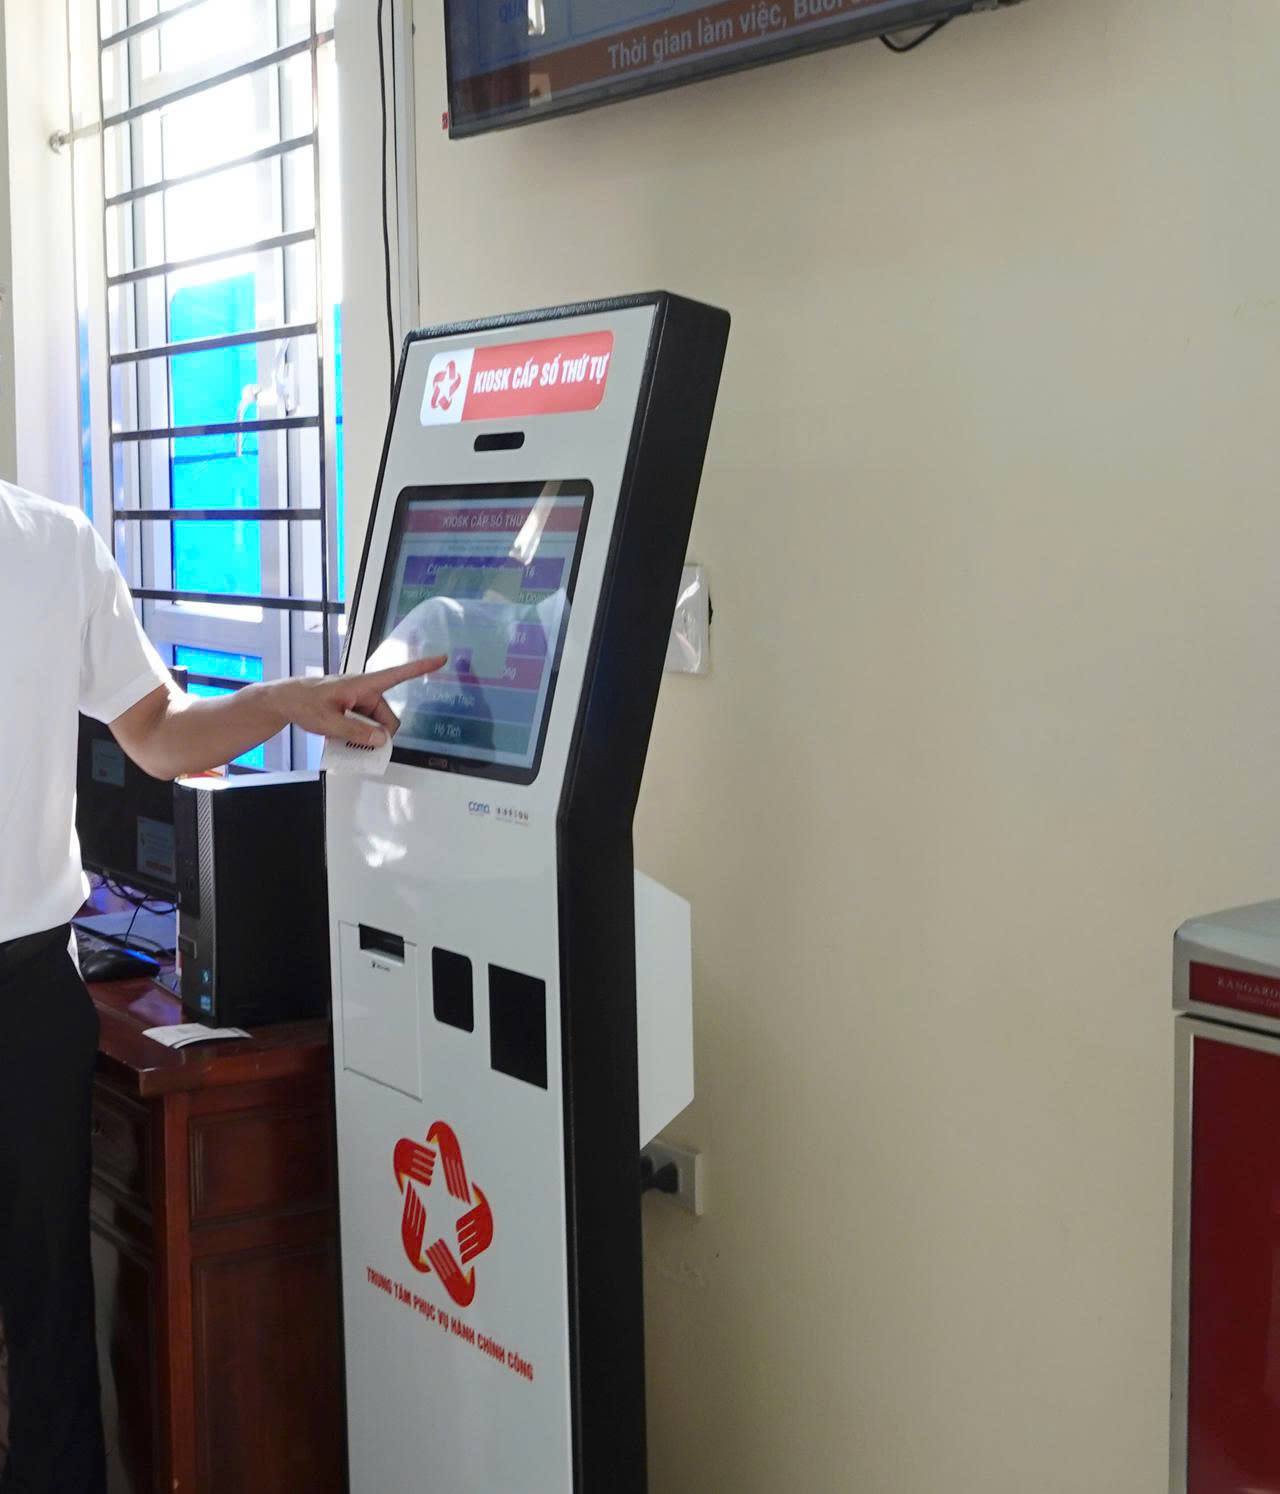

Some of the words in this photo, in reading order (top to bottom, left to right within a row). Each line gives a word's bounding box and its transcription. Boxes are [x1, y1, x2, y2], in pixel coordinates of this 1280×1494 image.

[608, 36, 648, 69] Thời
[653, 29, 692, 64] gian
[698, 17, 733, 44] làm
[738, 5, 787, 36] việc,
[473, 367, 512, 393] KIOSK
[512, 356, 539, 389] CẤP
[539, 353, 561, 386] SỐ
[561, 353, 590, 384] THỨ
[589, 352, 609, 384] TỰ
[442, 514, 468, 528] KIOSK
[1217, 976, 1280, 1000] KANGARO
[366, 1266, 392, 1294] TRUNG
[393, 1281, 411, 1307] TÂM
[413, 1294, 435, 1321] PHỤC
[437, 1308, 448, 1332] VỤ
[450, 1315, 474, 1345] HÀNH
[477, 1333, 505, 1364] CHÍNH
[507, 1350, 533, 1381] CÔNG
